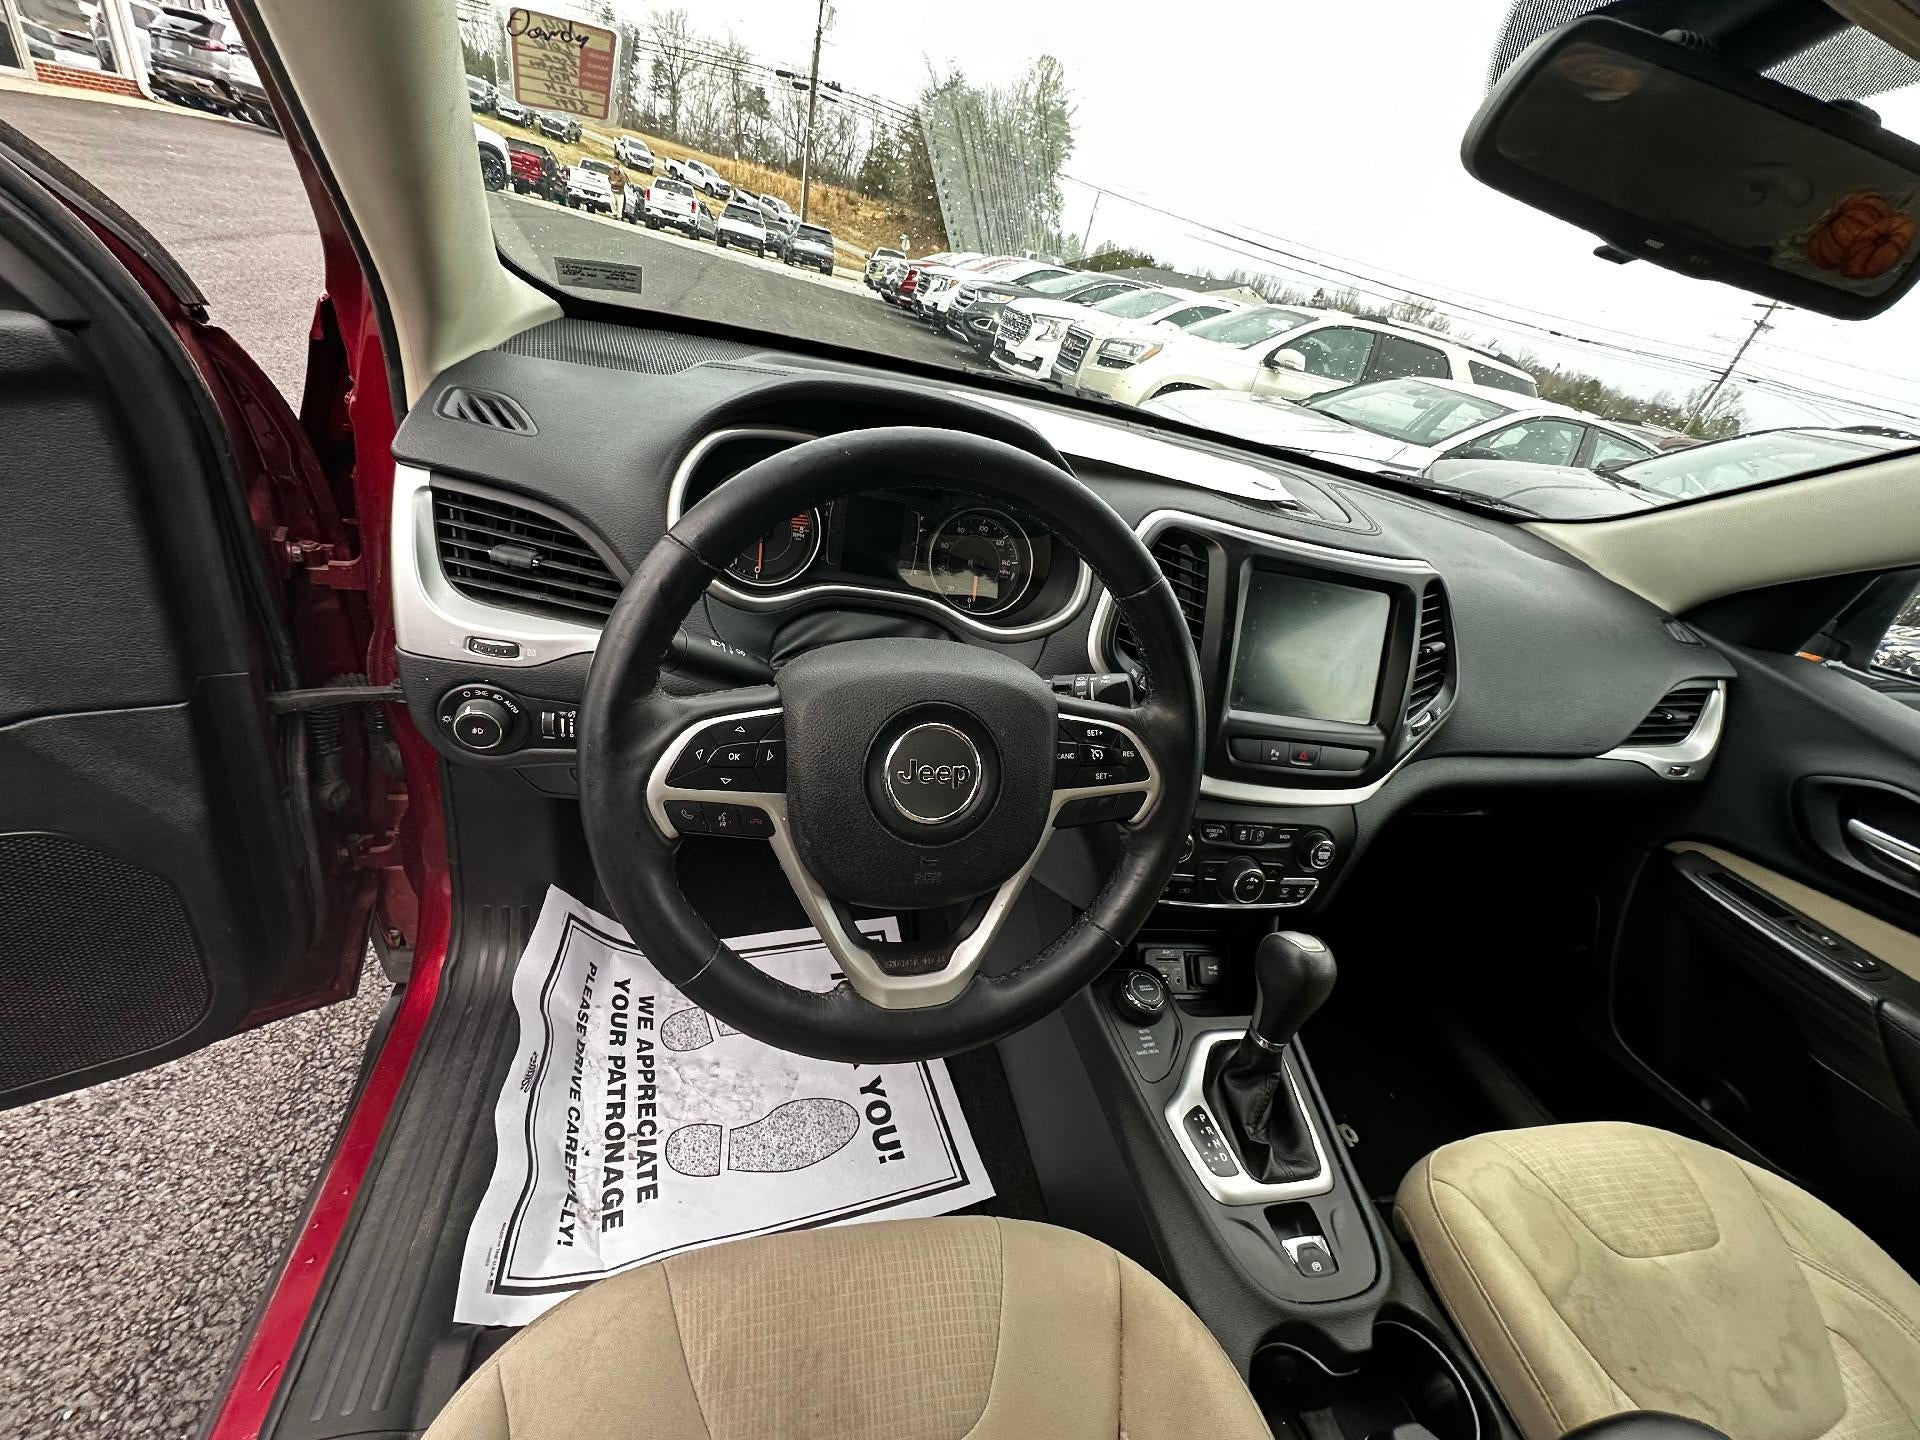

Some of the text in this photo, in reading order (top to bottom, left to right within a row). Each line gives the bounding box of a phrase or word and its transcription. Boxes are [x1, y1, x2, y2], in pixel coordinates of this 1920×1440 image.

[503, 700, 520, 714] AUTO
[728, 752, 741, 761] OK
[1122, 750, 1135, 758] RES
[897, 758, 972, 789] Jeep
[557, 961, 598, 1248] PLEASE DRIVE CAREFULLY!
[601, 977, 632, 1233] YOUR PATRONAGE
[636, 995, 659, 1204] WE APPRECIATE
[859, 1074, 905, 1164] YOU!
[1198, 1113, 1206, 1123] P
[1205, 1126, 1215, 1136] R
[1211, 1139, 1222, 1149] N
[1219, 1152, 1228, 1162] D
